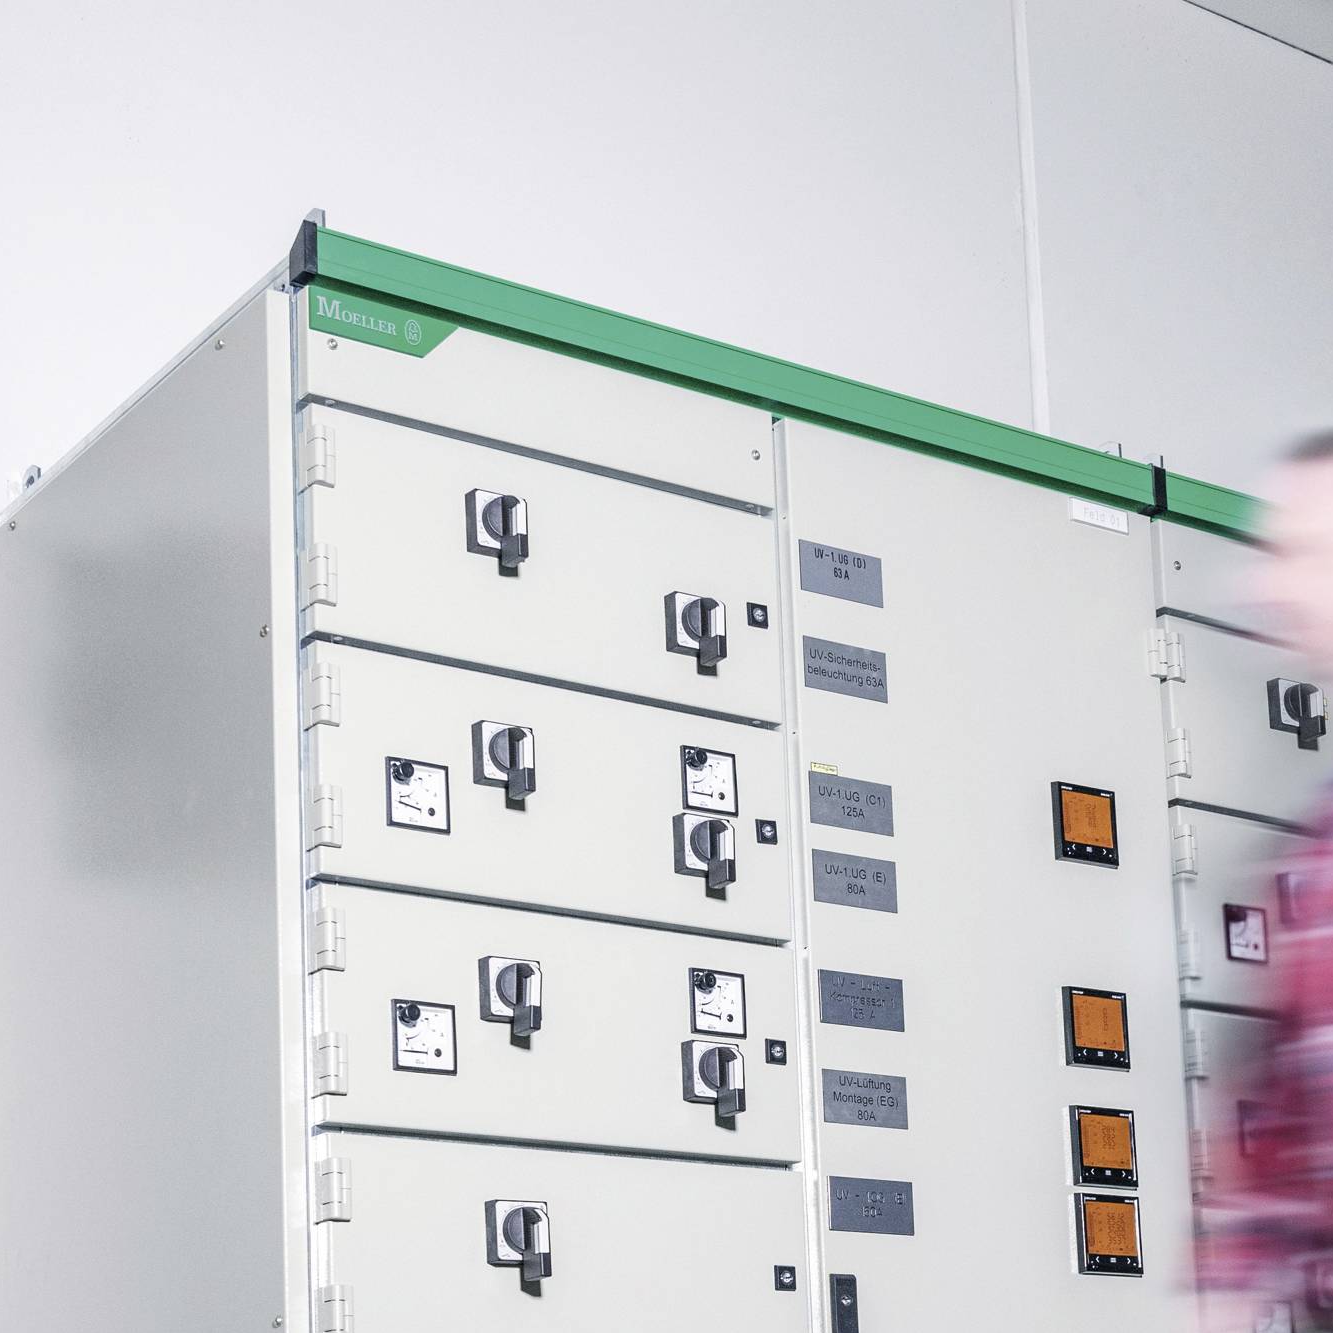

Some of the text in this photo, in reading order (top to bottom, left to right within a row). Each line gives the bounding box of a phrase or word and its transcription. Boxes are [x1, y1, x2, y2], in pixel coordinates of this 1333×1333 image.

[809, 648, 881, 672] UV-Sicherheits-
[807, 664, 884, 689] beleuchtung 63A
[865, 794, 886, 808] (C1)
[841, 805, 865, 819] 125A
[872, 871, 886, 885] (E)
[847, 883, 866, 895] 80A
[839, 1075, 891, 1093] UV-Lüftung
[833, 1091, 899, 1109] Montage (EG)
[857, 1109, 876, 1121] 80A
